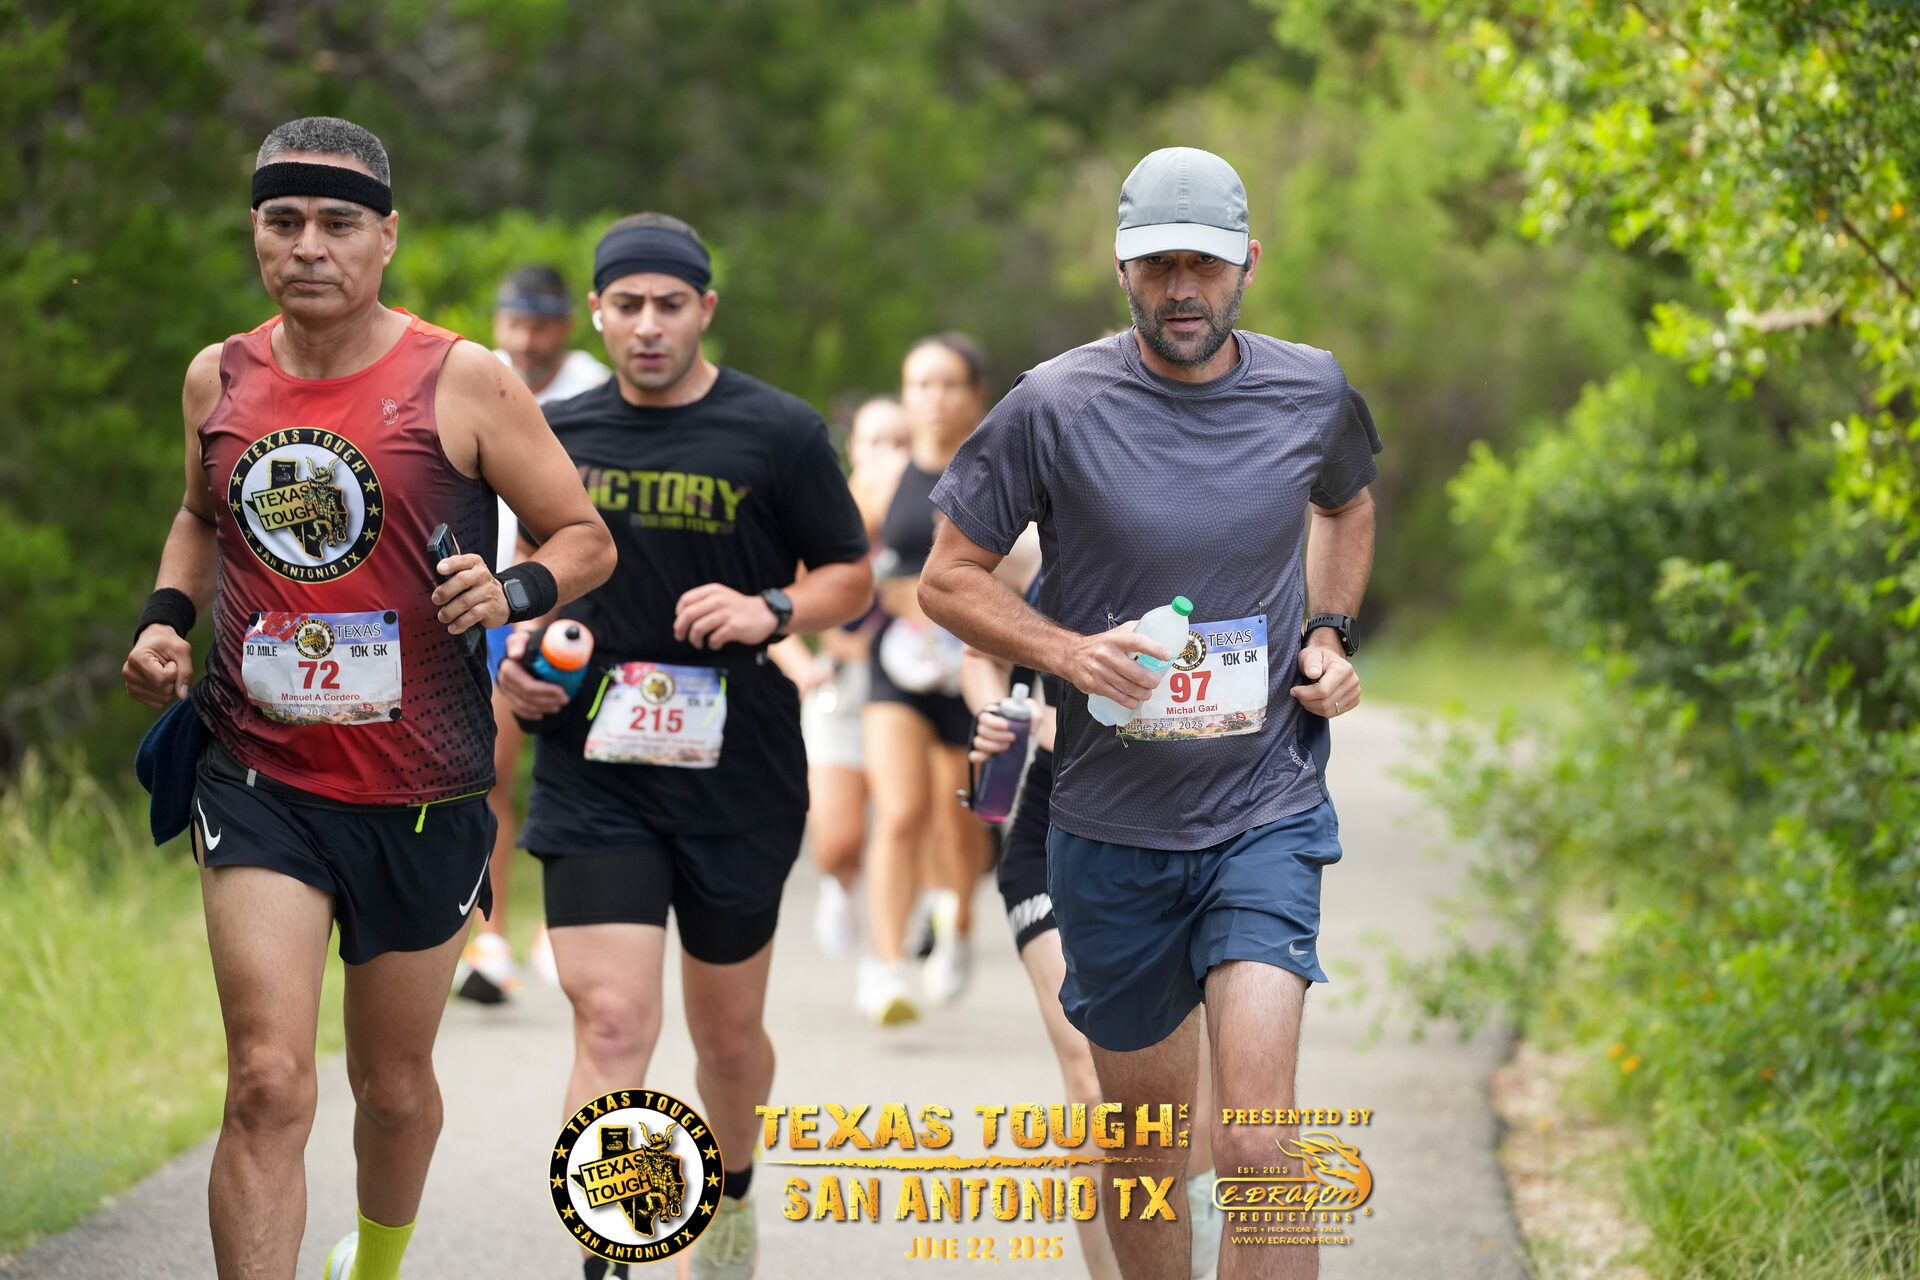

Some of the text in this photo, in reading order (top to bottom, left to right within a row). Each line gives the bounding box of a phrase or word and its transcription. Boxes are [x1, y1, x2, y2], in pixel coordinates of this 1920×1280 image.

[243, 429, 367, 473] TEXAS TOUGH
[255, 485, 310, 509] TEXAS
[261, 505, 318, 527] TOUGH
[257, 545, 361, 579] SAN ANTONIO TX
[335, 624, 382, 639] TEXAS
[1207, 629, 1252, 647] TEXAS
[246, 645, 278, 657] 10 MILE
[350, 644, 388, 658] 10K 5K
[1221, 650, 1258, 666] 10K 5K
[298, 660, 340, 690] 72
[1169, 670, 1212, 703] 97
[281, 693, 360, 701] Manuel A Cordero
[307, 708, 330, 717] 2025
[1166, 704, 1218, 715] Michal Gazi
[630, 706, 684, 733] 215
[1179, 721, 1203, 730] 2025
